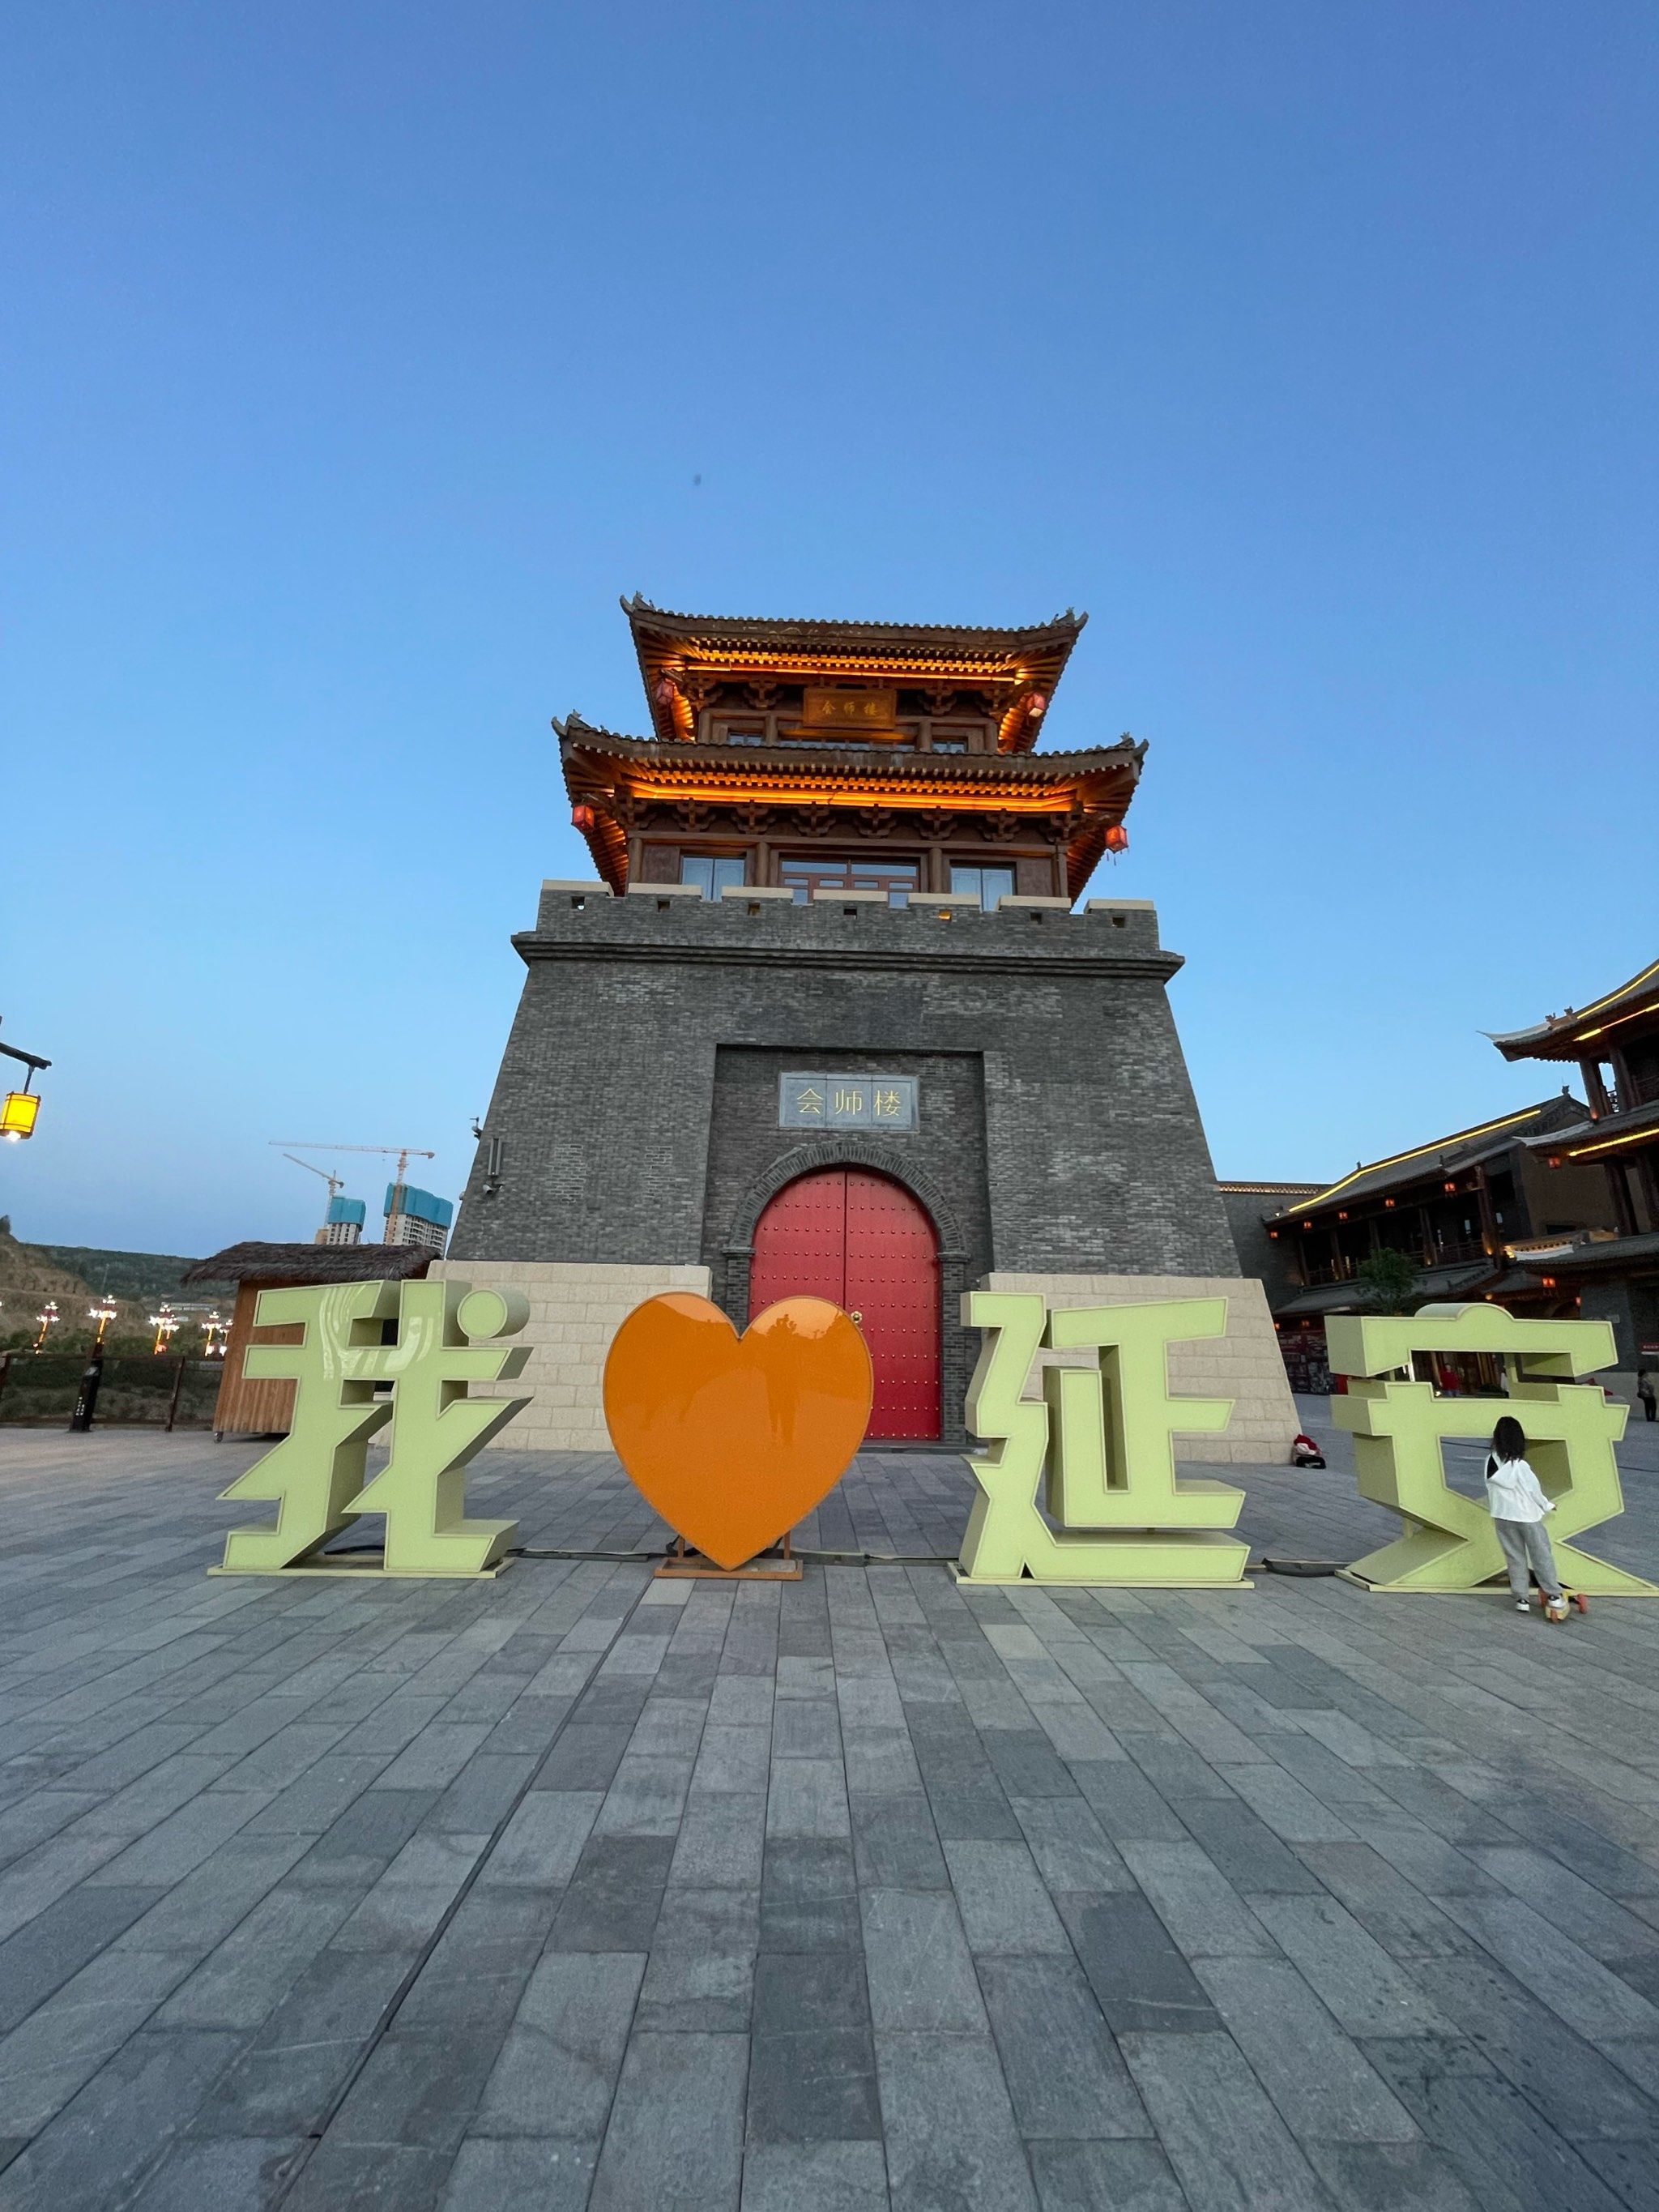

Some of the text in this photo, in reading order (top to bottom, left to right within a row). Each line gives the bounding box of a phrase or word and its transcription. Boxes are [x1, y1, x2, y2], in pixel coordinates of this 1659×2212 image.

[796, 1087, 902, 1117] 会师楼
[216, 1279, 1659, 1589] 我 延安
